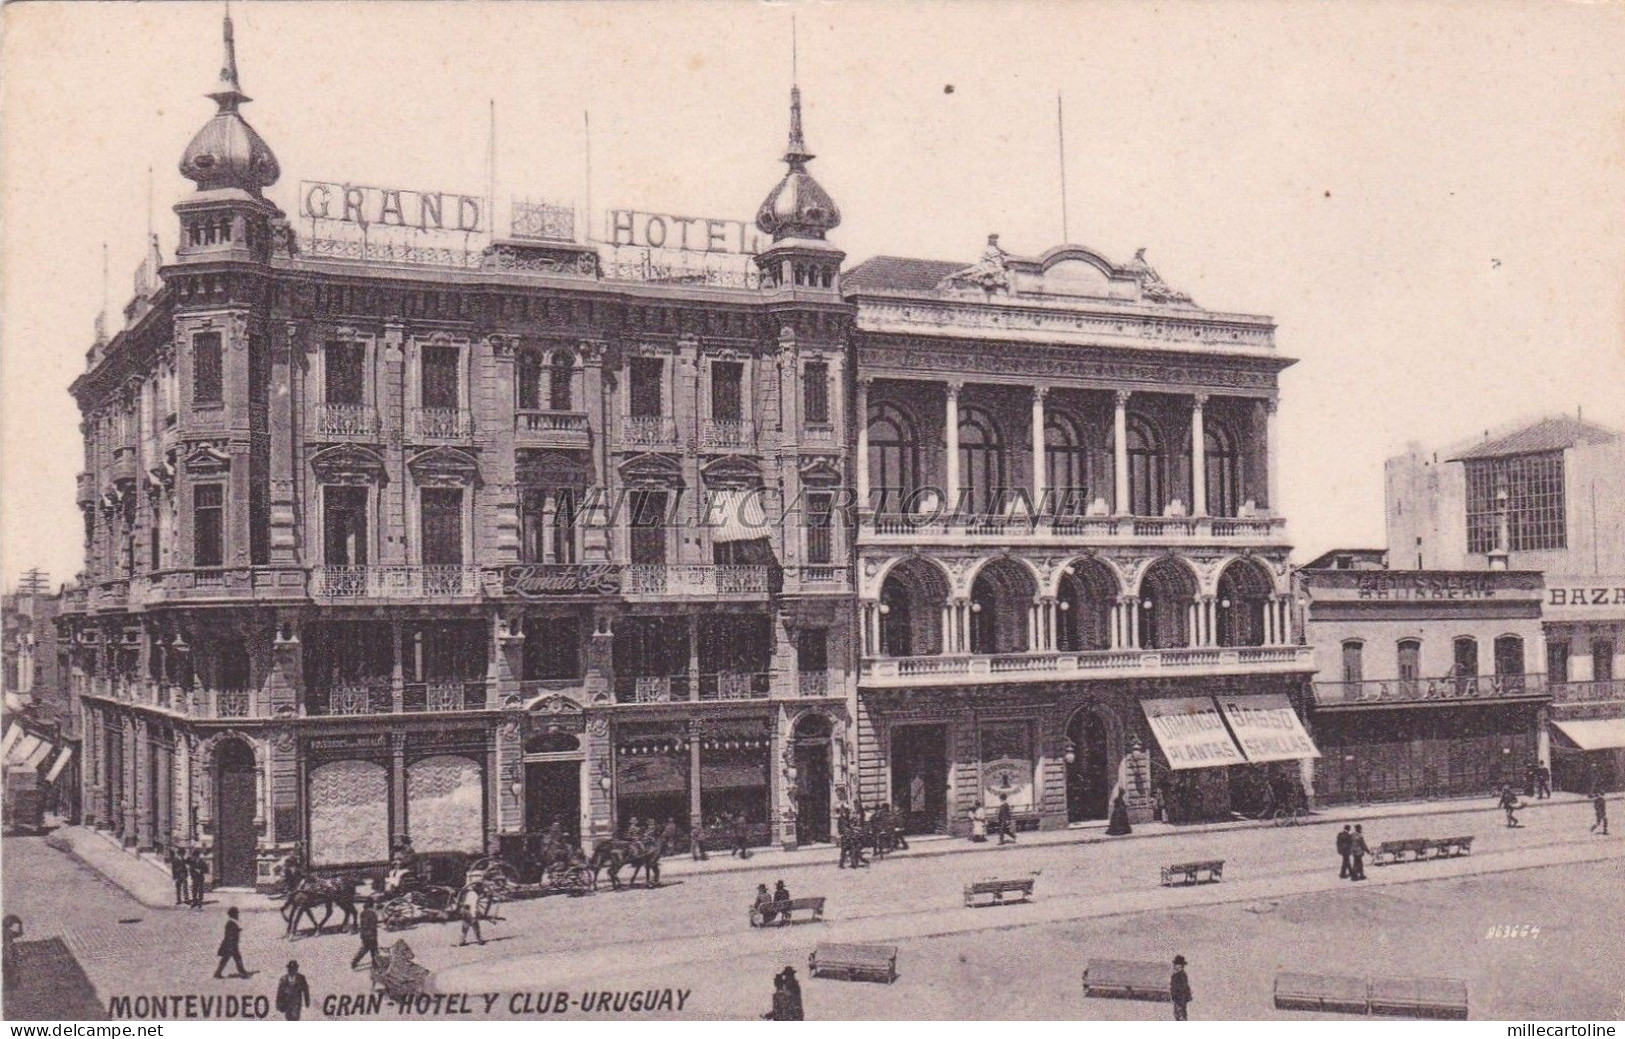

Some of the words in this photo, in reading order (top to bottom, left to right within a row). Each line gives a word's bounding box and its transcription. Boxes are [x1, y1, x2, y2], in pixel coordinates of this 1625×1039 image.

[304, 182, 482, 232] GRAND
[609, 209, 759, 255] HOTEL
[1165, 741, 1236, 762] PLANTAS
